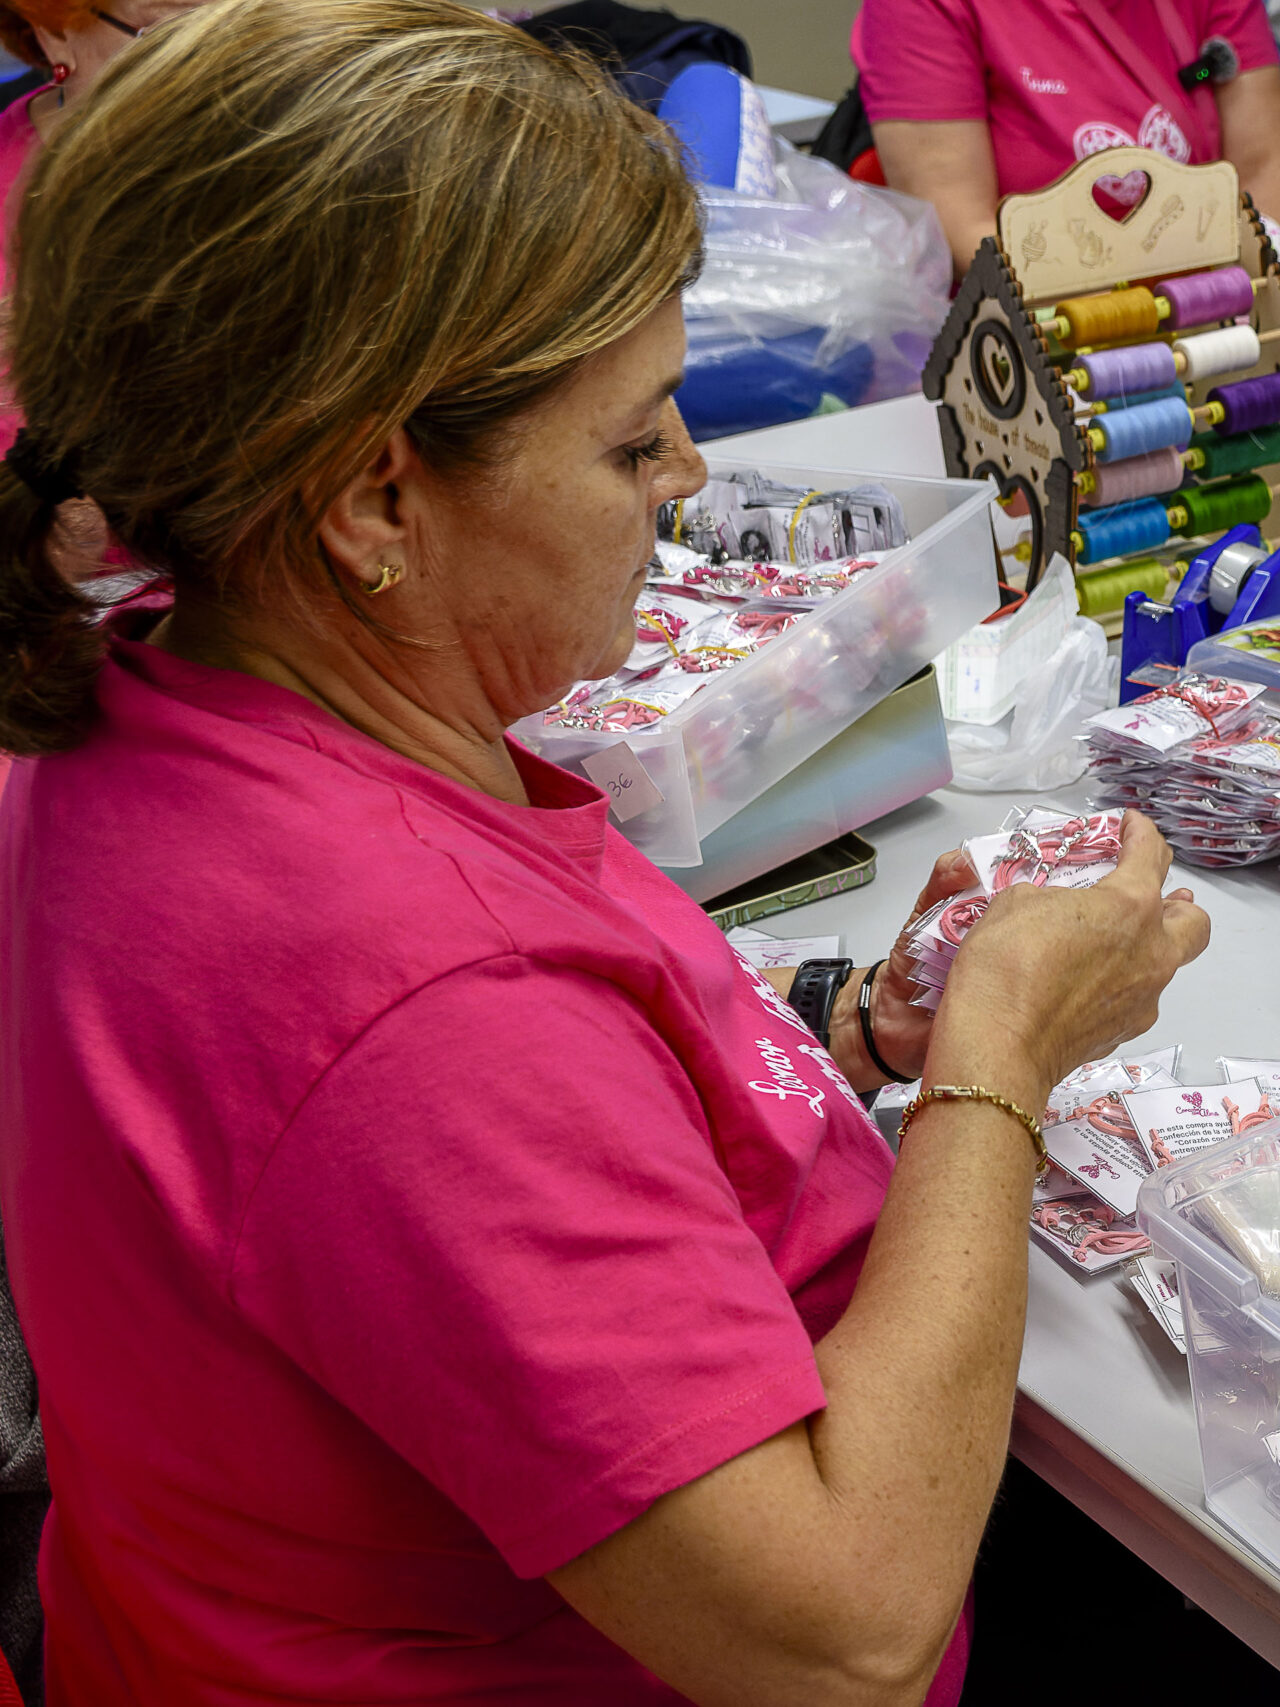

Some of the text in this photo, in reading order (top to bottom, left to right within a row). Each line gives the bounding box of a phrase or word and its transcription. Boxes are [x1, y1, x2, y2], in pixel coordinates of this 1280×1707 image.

[1167, 1123, 1184, 1133] esta
[1185, 1121, 1214, 1132] compra
[1085, 1126, 1115, 1152] almohada
[1088, 1138, 1111, 1156] ayudas
[1109, 1154, 1134, 1171] compra
